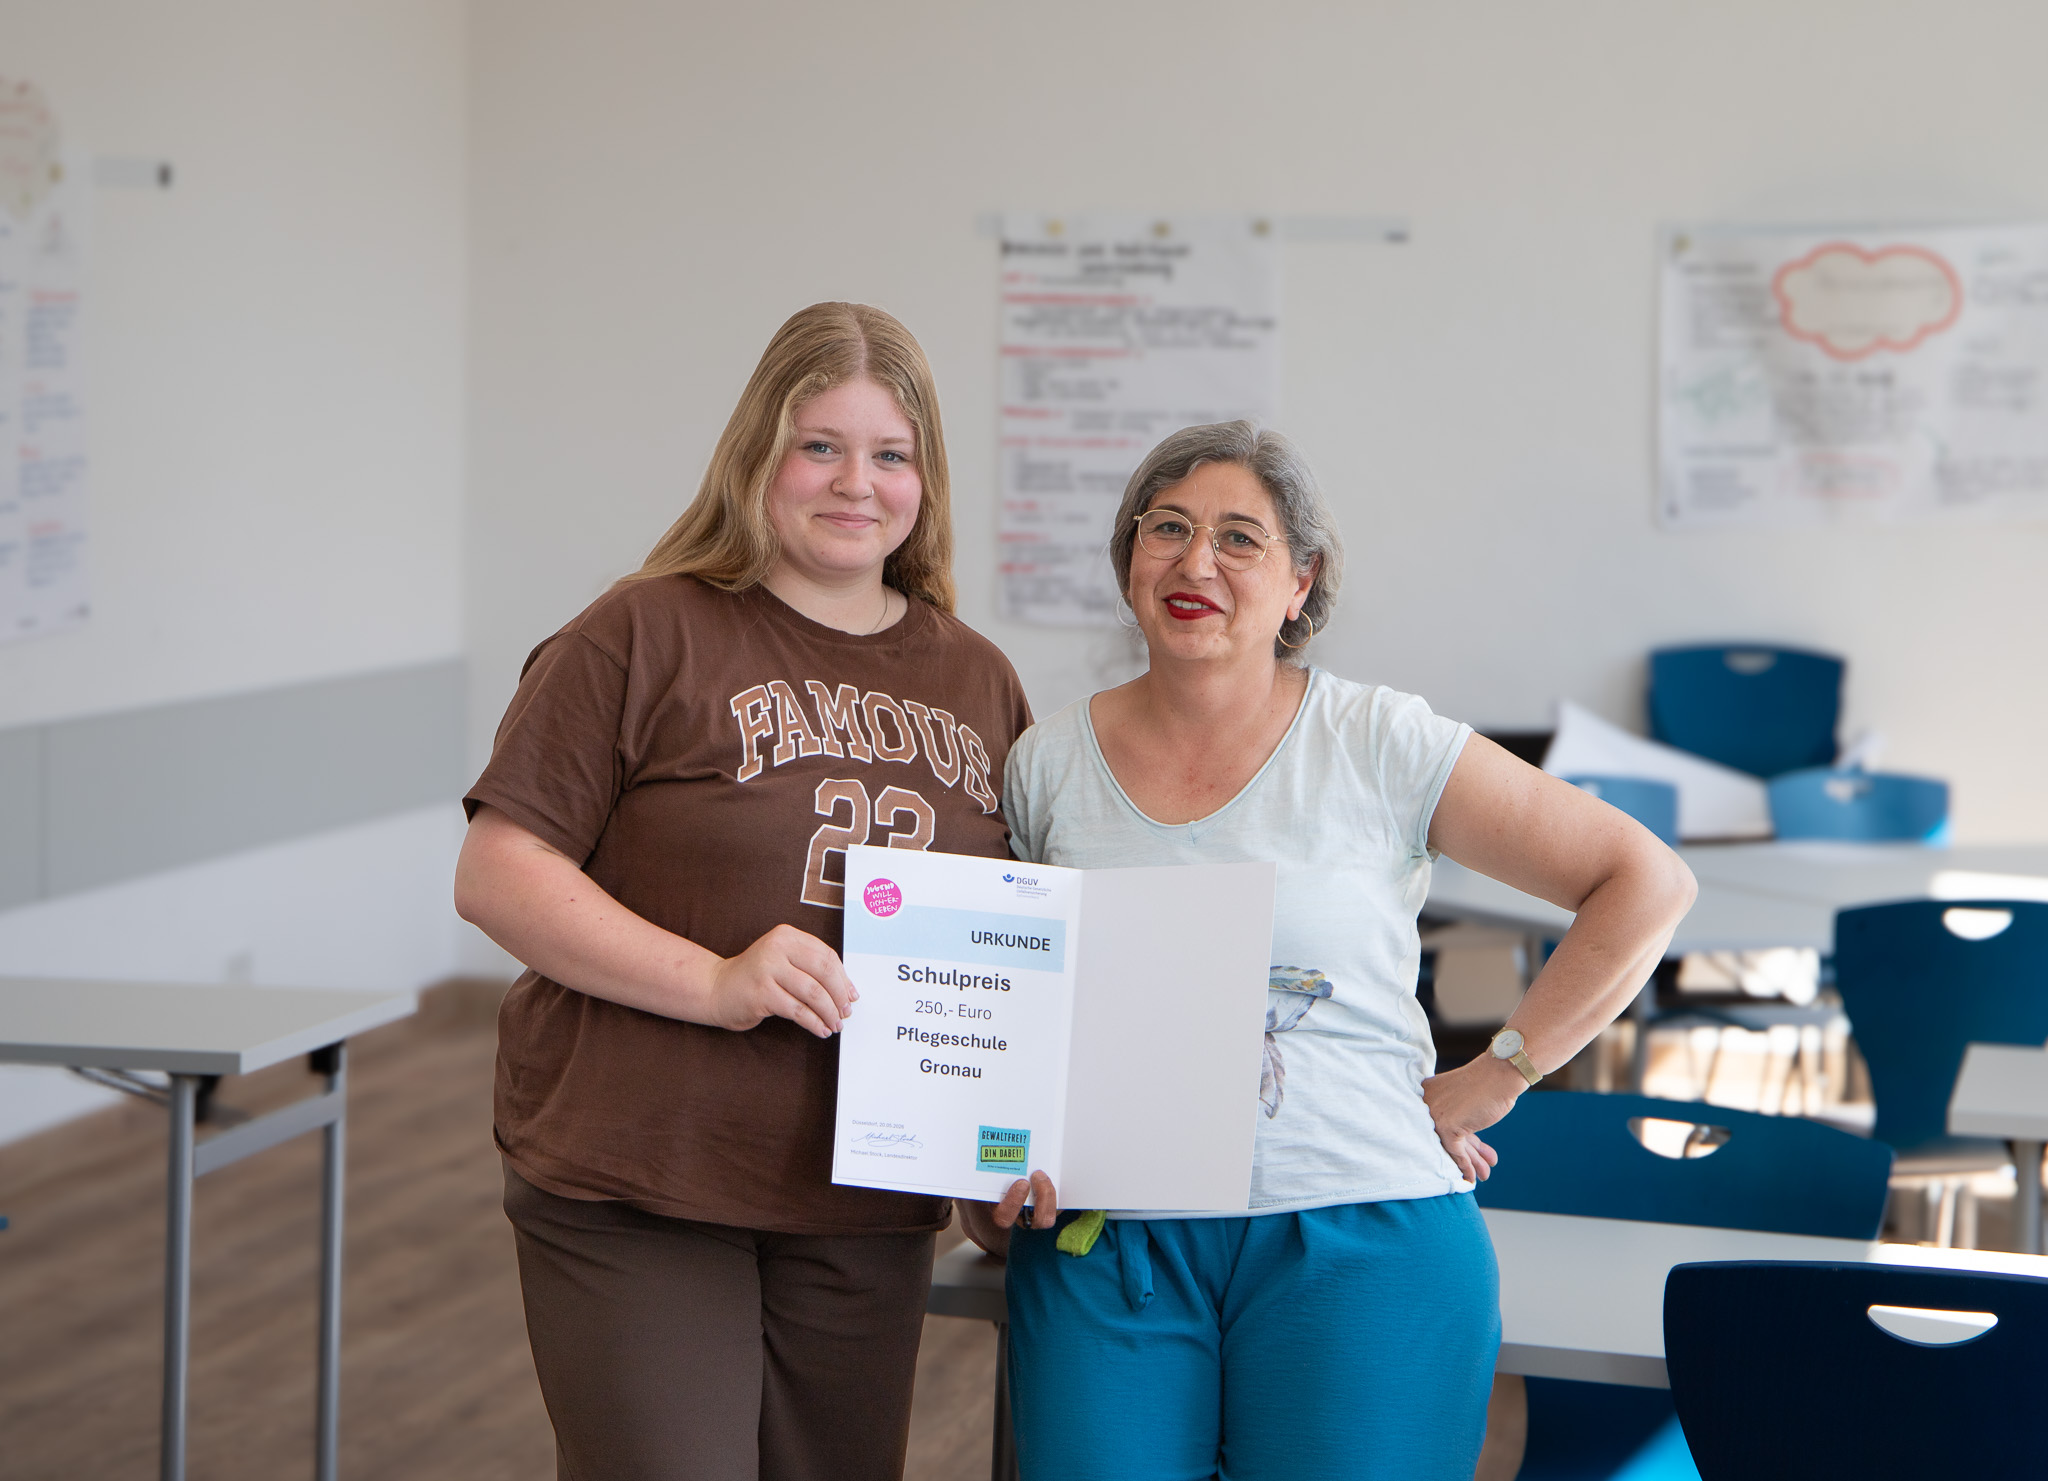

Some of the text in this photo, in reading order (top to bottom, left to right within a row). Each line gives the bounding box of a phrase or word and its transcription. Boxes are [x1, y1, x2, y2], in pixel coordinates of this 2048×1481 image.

[730, 680, 998, 814] FAMOUS
[866, 882, 895, 896] JUGEND
[1016, 877, 1039, 886] DGUV
[872, 890, 893, 899] WILL
[874, 905, 898, 915] LEBEN
[971, 930, 1051, 952] URKUNDE
[897, 963, 1012, 992] Schulpreis
[915, 999, 992, 1020] 250,- Euro
[896, 1025, 1008, 1051] Pflegeschule
[919, 1058, 982, 1079] Gronau
[981, 1130, 1027, 1143] GEWALTFREI?
[984, 1148, 1022, 1158] BIN DABEI!
